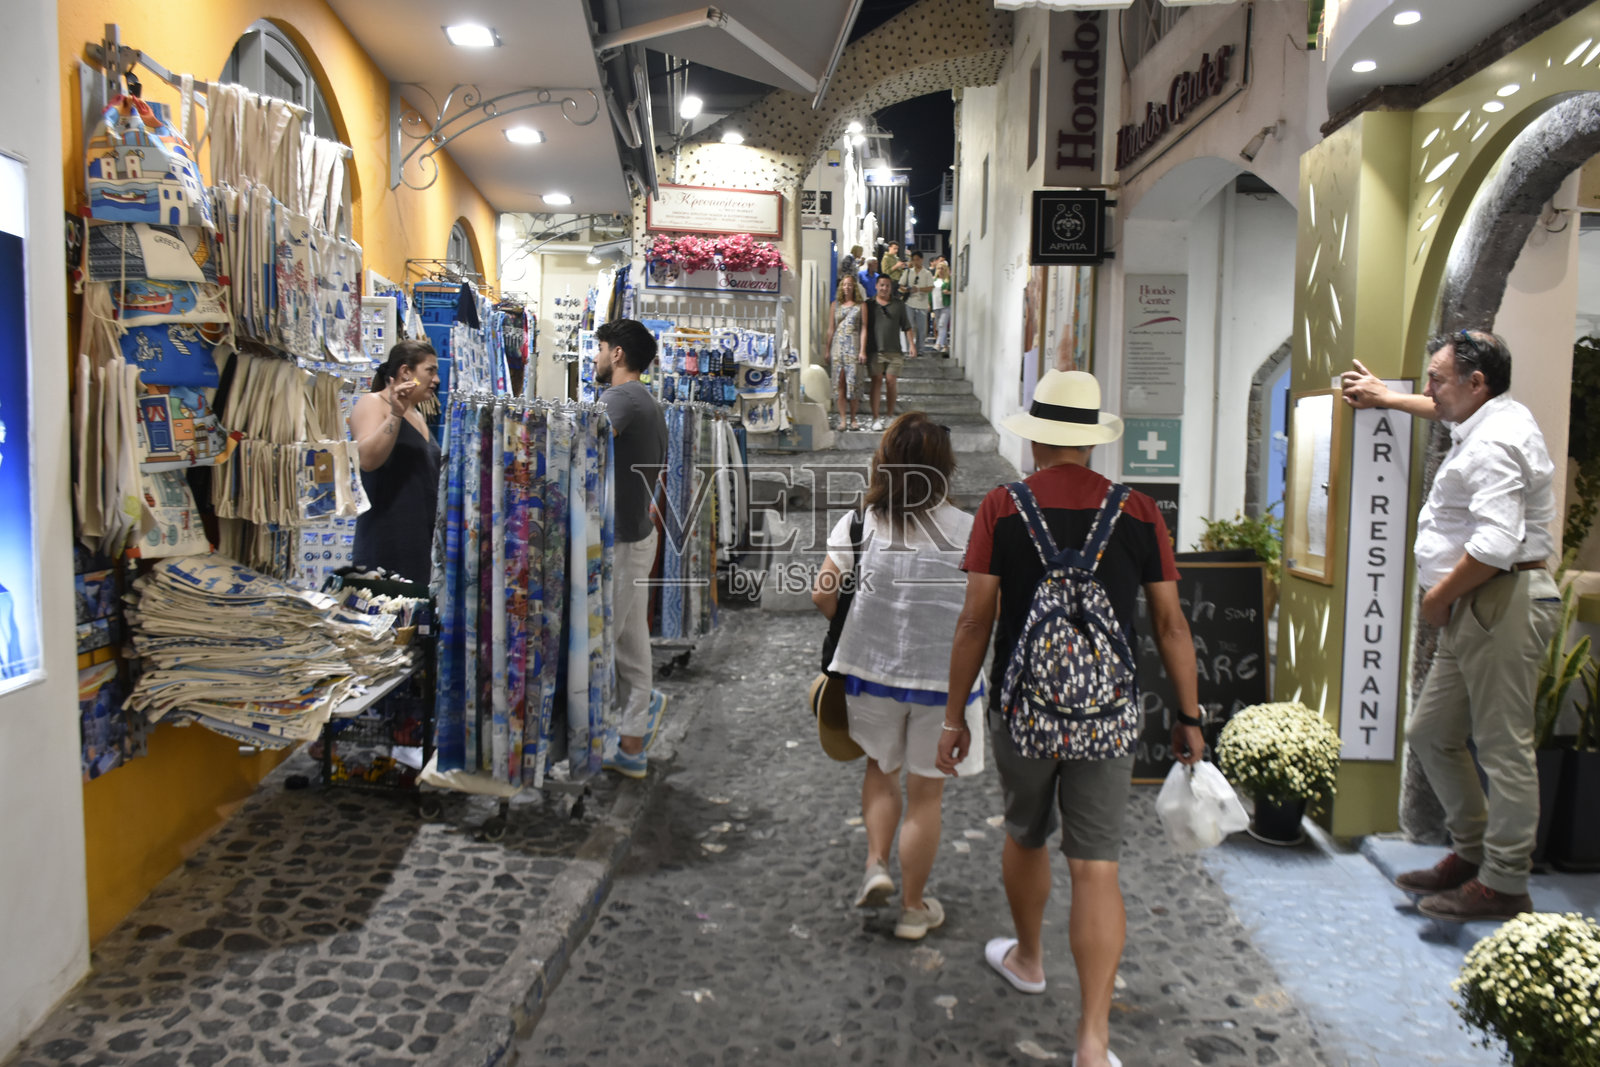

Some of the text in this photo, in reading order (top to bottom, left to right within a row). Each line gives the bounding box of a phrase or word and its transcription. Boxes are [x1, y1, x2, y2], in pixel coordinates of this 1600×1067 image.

[1115, 44, 1234, 171] Hondos Center
[719, 273, 777, 290] Souvenirs
[1138, 294, 1171, 305] Center
[1139, 284, 1176, 296] Hondos
[1372, 406, 1393, 463] AR
[1359, 494, 1389, 746] RESTAURANT
